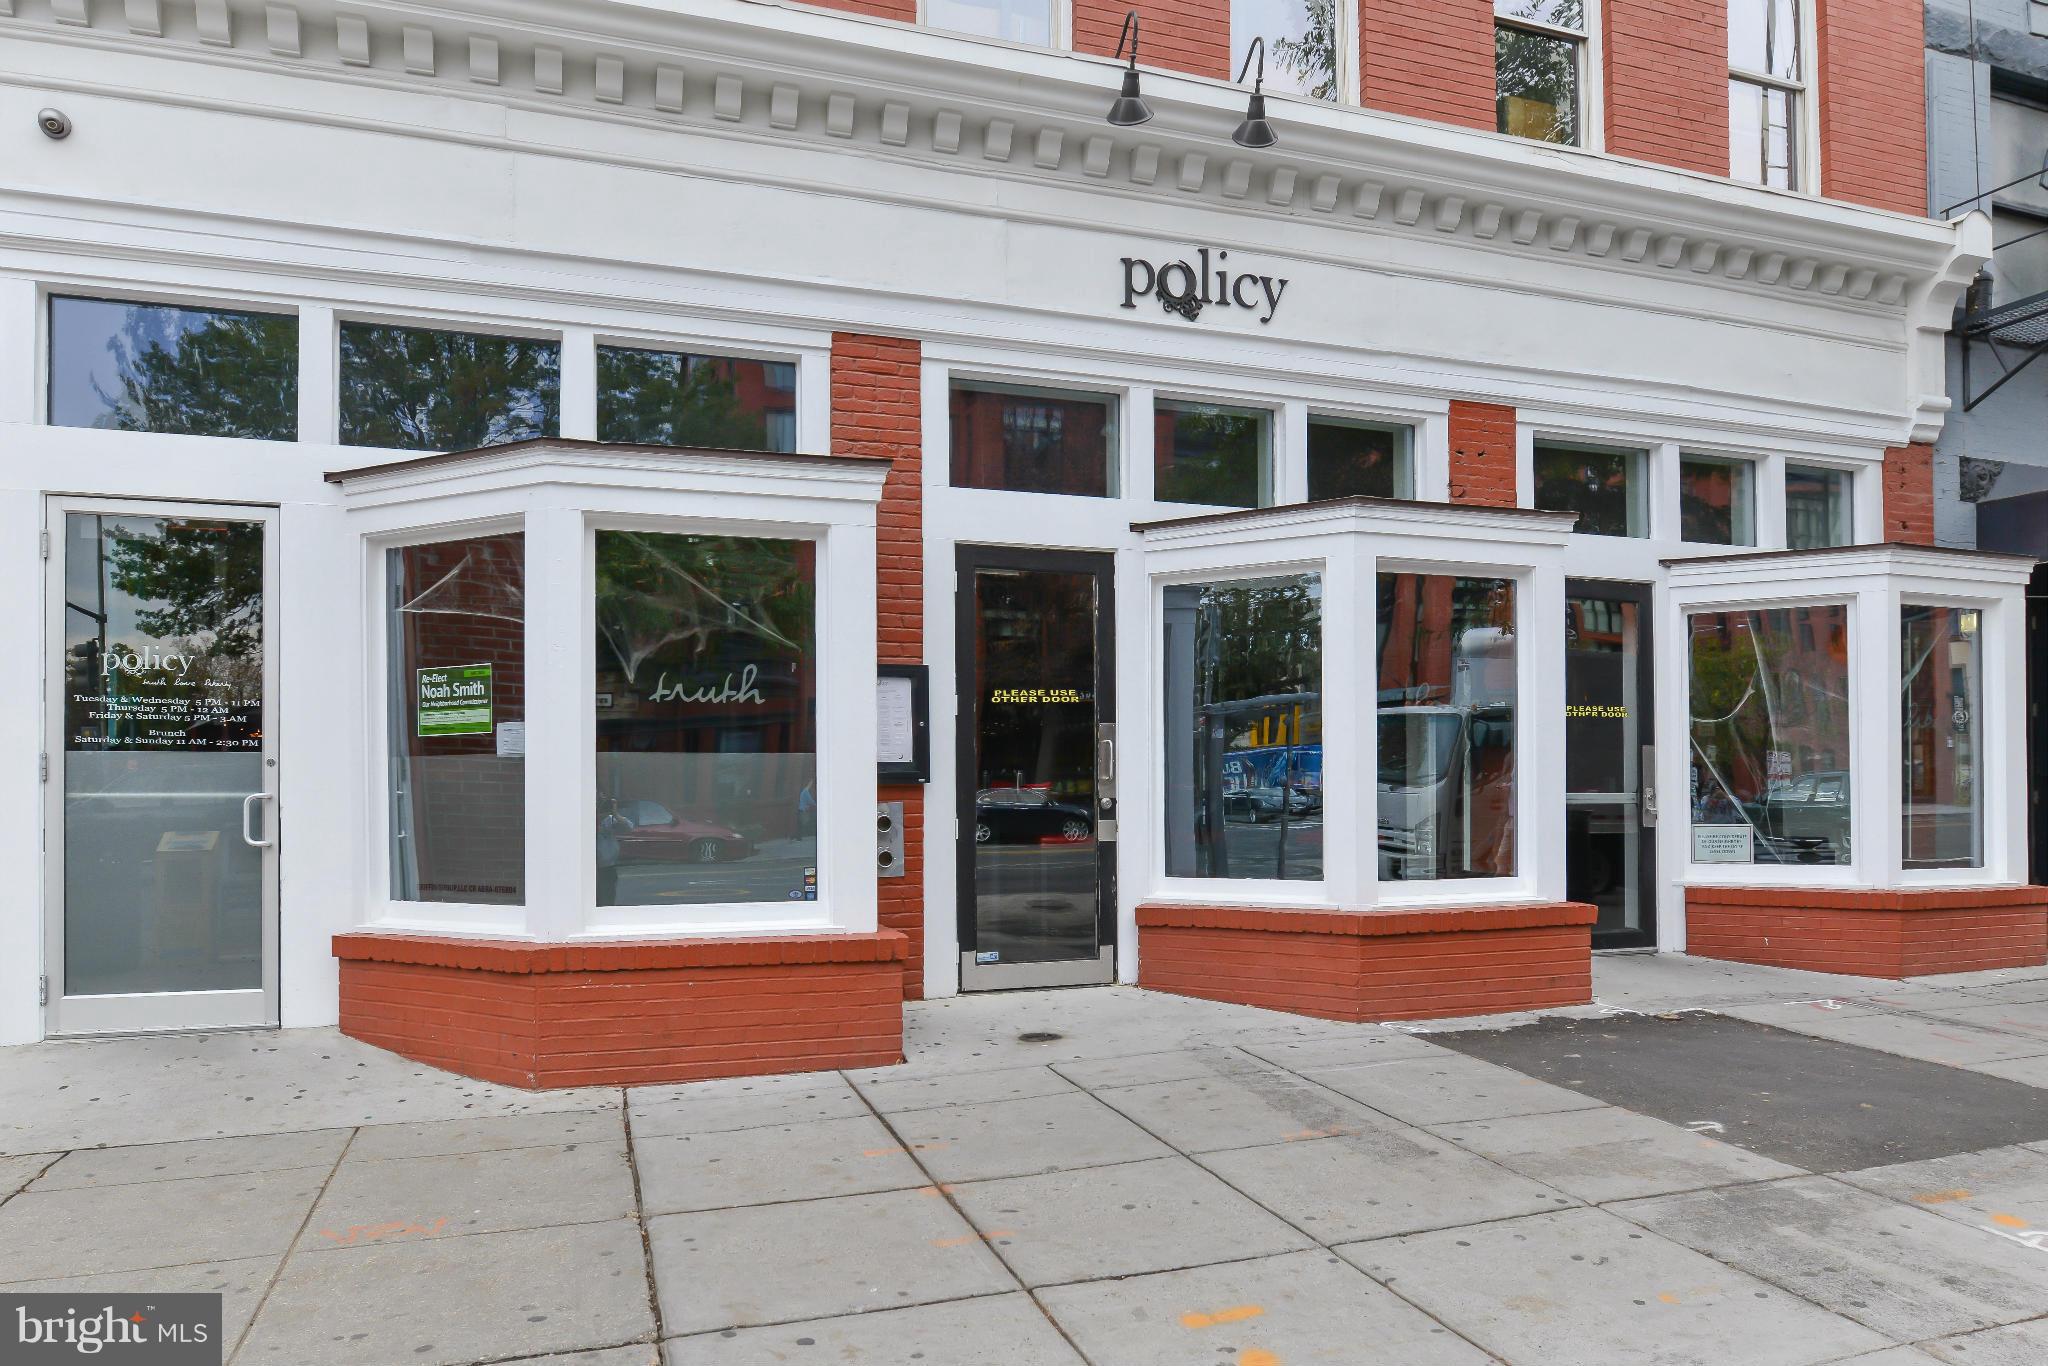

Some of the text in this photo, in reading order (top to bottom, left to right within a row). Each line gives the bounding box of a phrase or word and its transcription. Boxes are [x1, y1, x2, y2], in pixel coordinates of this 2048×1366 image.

[1119, 248, 1290, 324] policy
[101, 645, 196, 677] policy
[421, 681, 485, 699] Noah Smith
[648, 663, 766, 705] truth
[994, 689, 1046, 697] PLEASE
[1050, 689, 1076, 697] USE
[73, 694, 118, 704] Tuesday
[120, 695, 129, 704] &
[131, 696, 191, 706] Wednesday
[195, 698, 202, 707] 5
[204, 698, 222, 707] PM
[243, 699, 260, 708] PM
[106, 703, 156, 714] Thursday
[160, 706, 168, 714] 5
[170, 705, 188, 714] PM
[211, 706, 229, 715] AM
[88, 711, 122, 722] Friday
[124, 713, 134, 722] &
[135, 712, 183, 723] Saturday
[193, 714, 211, 723] PM
[228, 715, 247, 724] AM
[148, 729, 187, 738] Brunch
[74, 736, 121, 746] Saturday
[124, 737, 133, 746] &
[134, 737, 174, 748] Sunday
[188, 739, 207, 747] AM
[216, 740, 239, 748] 2:30
[241, 739, 260, 748] PM
